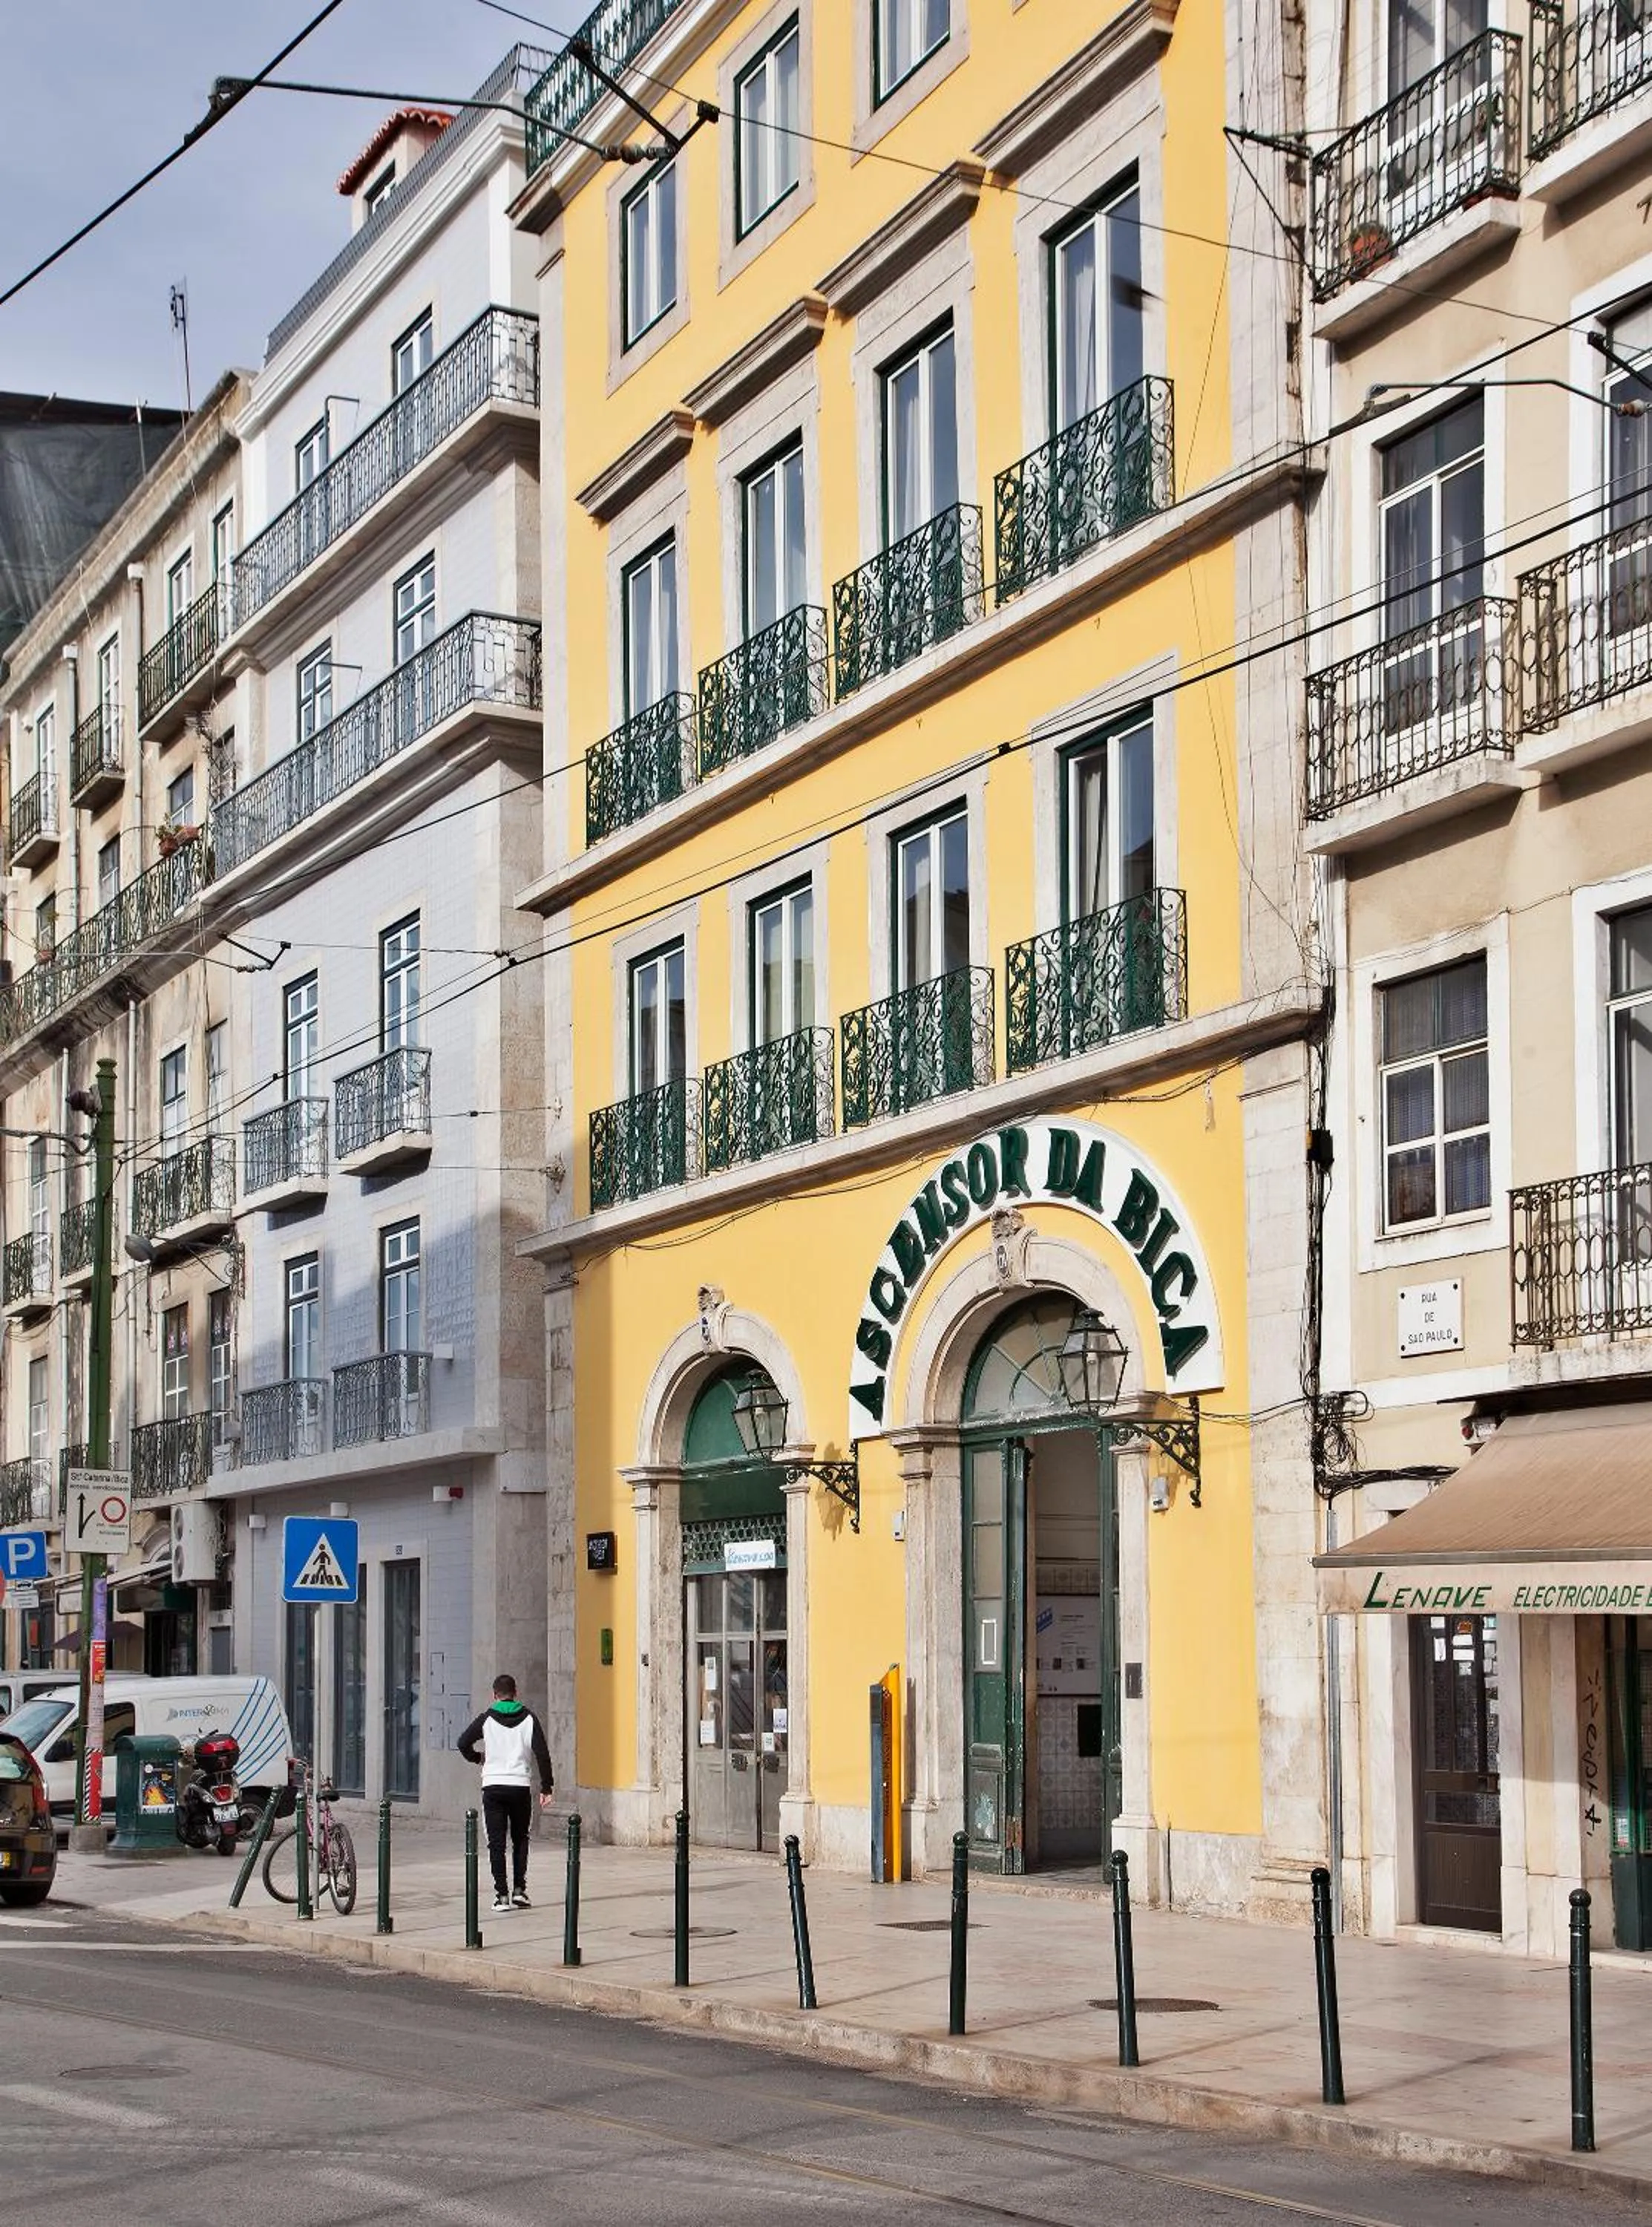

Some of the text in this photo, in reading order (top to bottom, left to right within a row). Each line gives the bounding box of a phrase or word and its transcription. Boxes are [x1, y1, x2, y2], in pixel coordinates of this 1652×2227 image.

[1043, 1127, 1107, 1214] DA
[1112, 1168, 1209, 1376] BICA
[1421, 1292, 1437, 1304] RUA
[1424, 1312, 1435, 1324] DE
[1426, 1328, 1452, 1342] PAULO
[8, 1537, 36, 1574] P
[1363, 1572, 1492, 1609] LENAVE
[1513, 1585, 1645, 1608] ELECTRICIDADE
